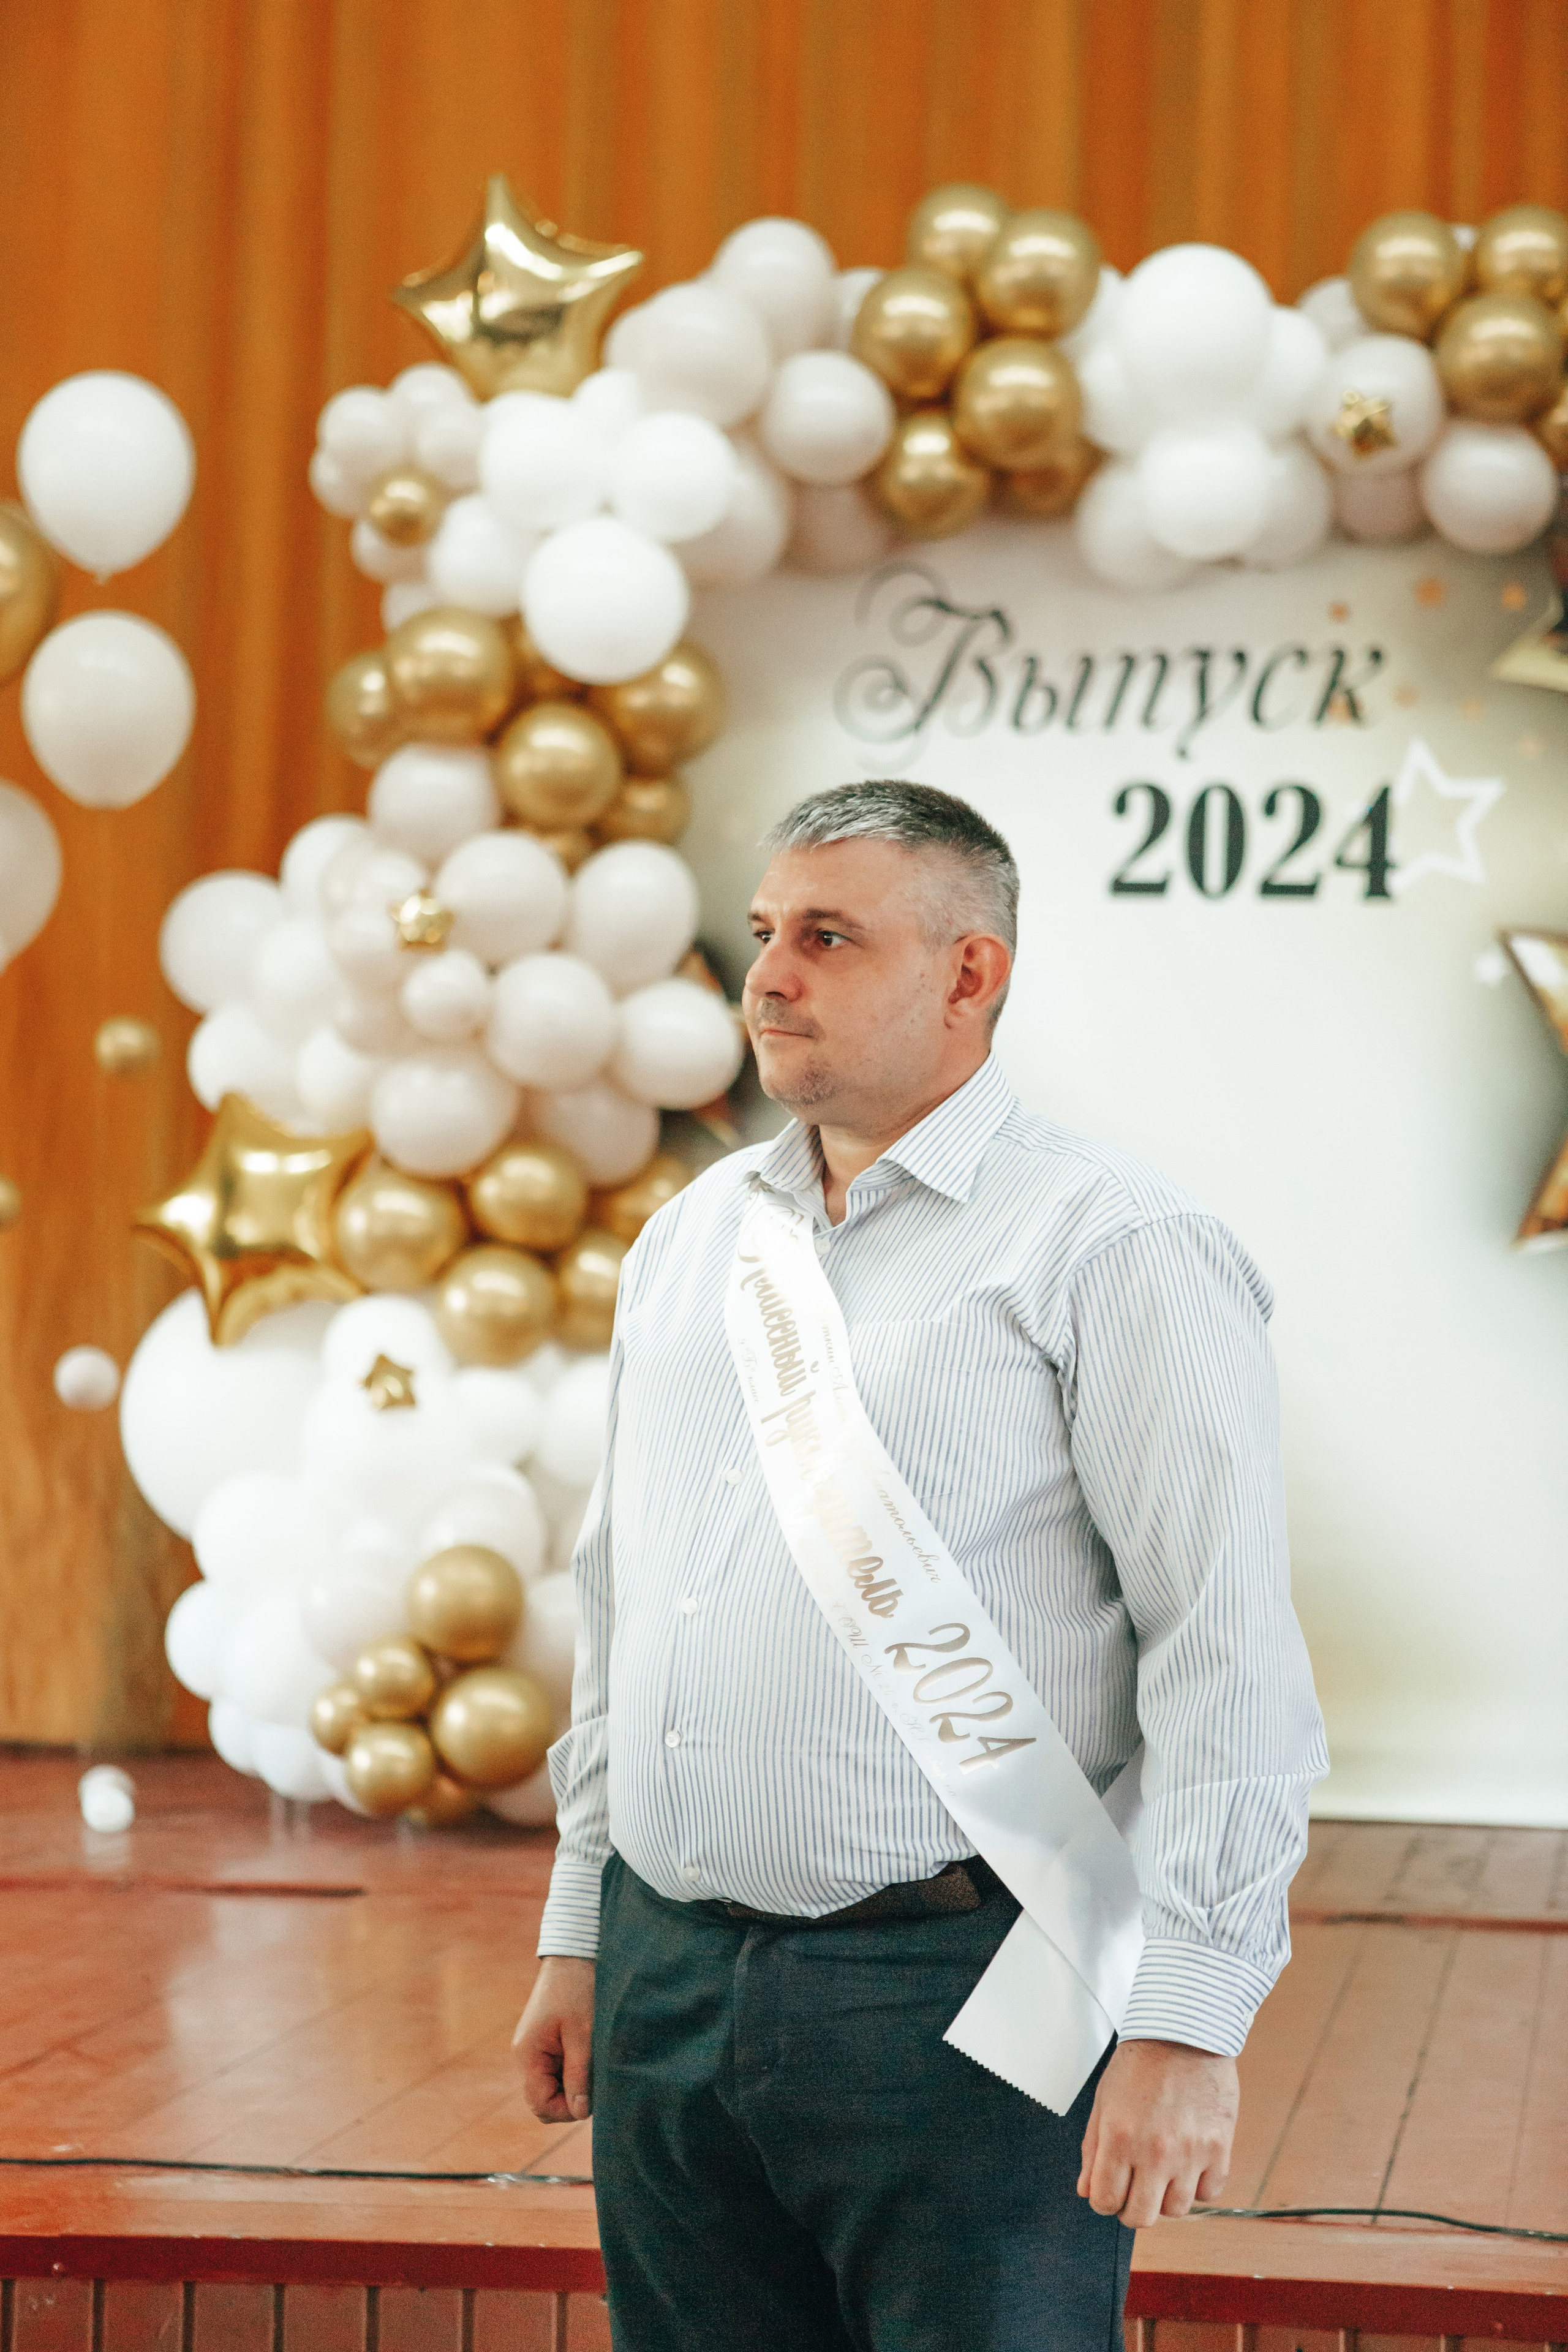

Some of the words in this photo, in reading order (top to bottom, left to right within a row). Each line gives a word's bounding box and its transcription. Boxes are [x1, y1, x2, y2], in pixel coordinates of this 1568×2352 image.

[834, 559, 1384, 773] Выпуск
[1110, 780, 1398, 900] 2024
[761, 1389, 904, 1618] рукитель
[884, 1623, 1037, 1775] 2024
